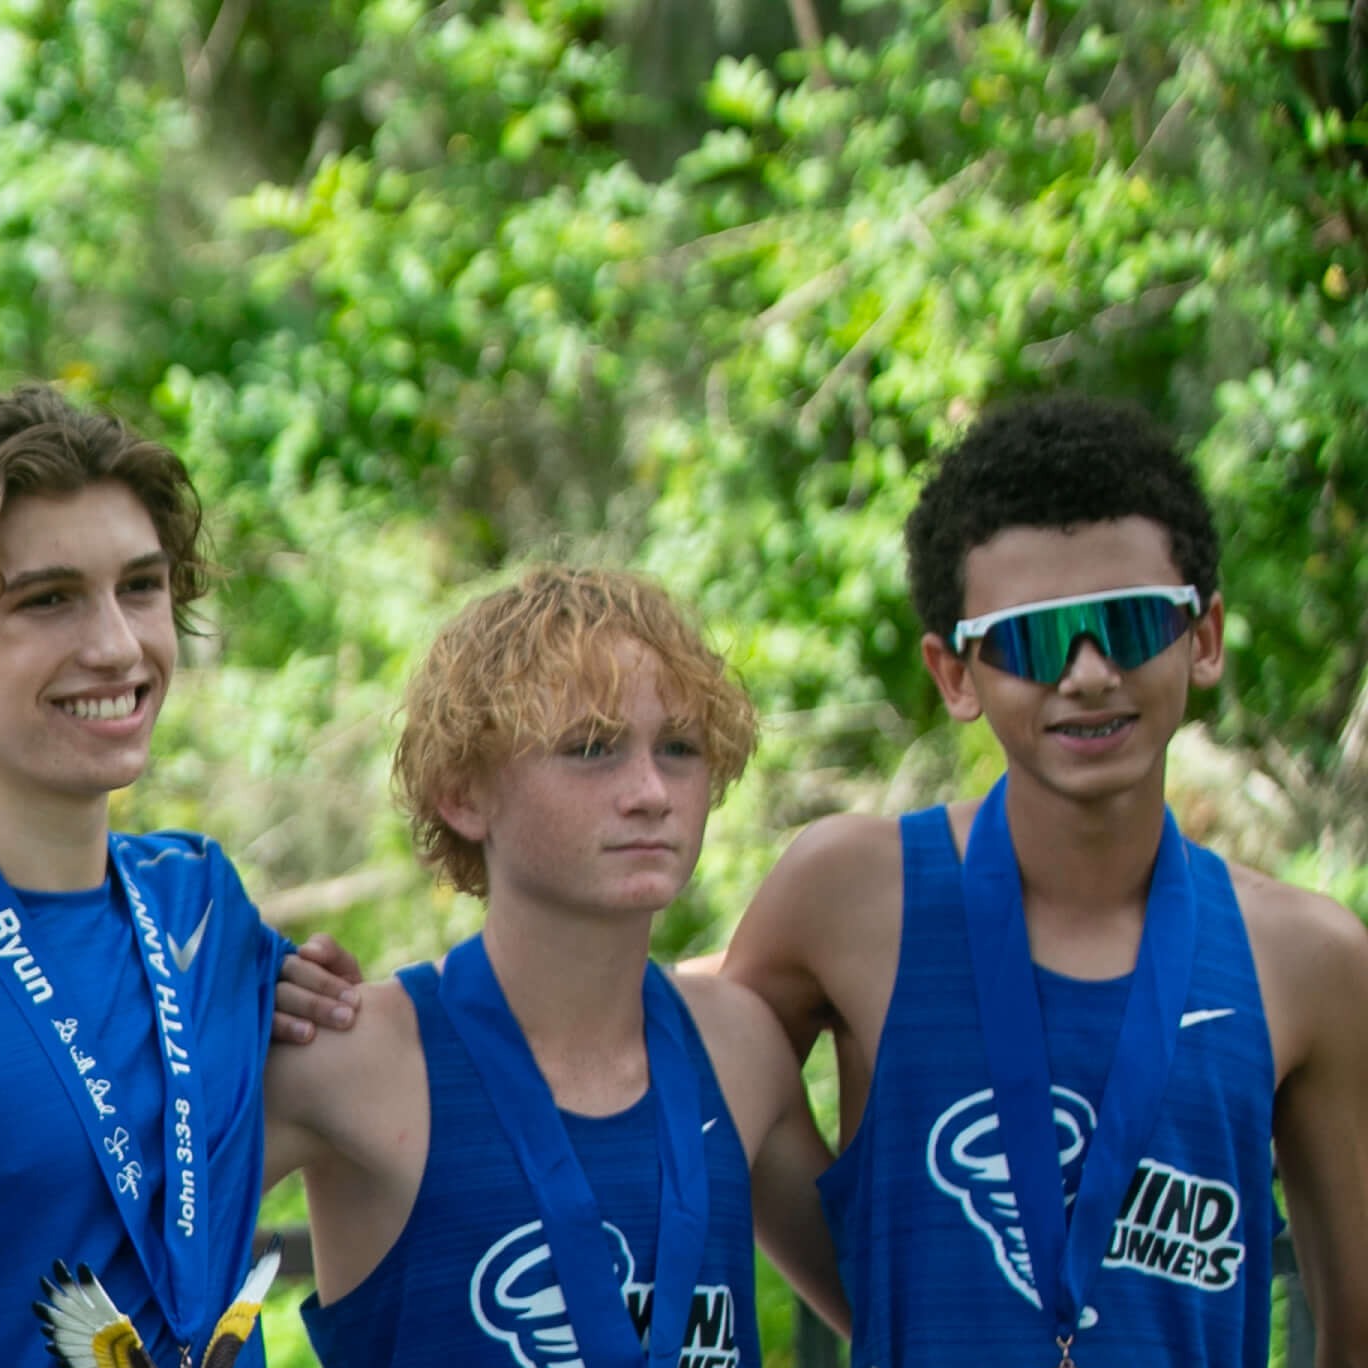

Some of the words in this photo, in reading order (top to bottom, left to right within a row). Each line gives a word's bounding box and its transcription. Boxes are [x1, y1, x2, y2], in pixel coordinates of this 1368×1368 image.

[155, 983, 191, 1076] 17TH
[174, 1098, 194, 1164] 3:3-8
[175, 1170, 195, 1237] John
[1105, 1229, 1241, 1286] UNNERS
